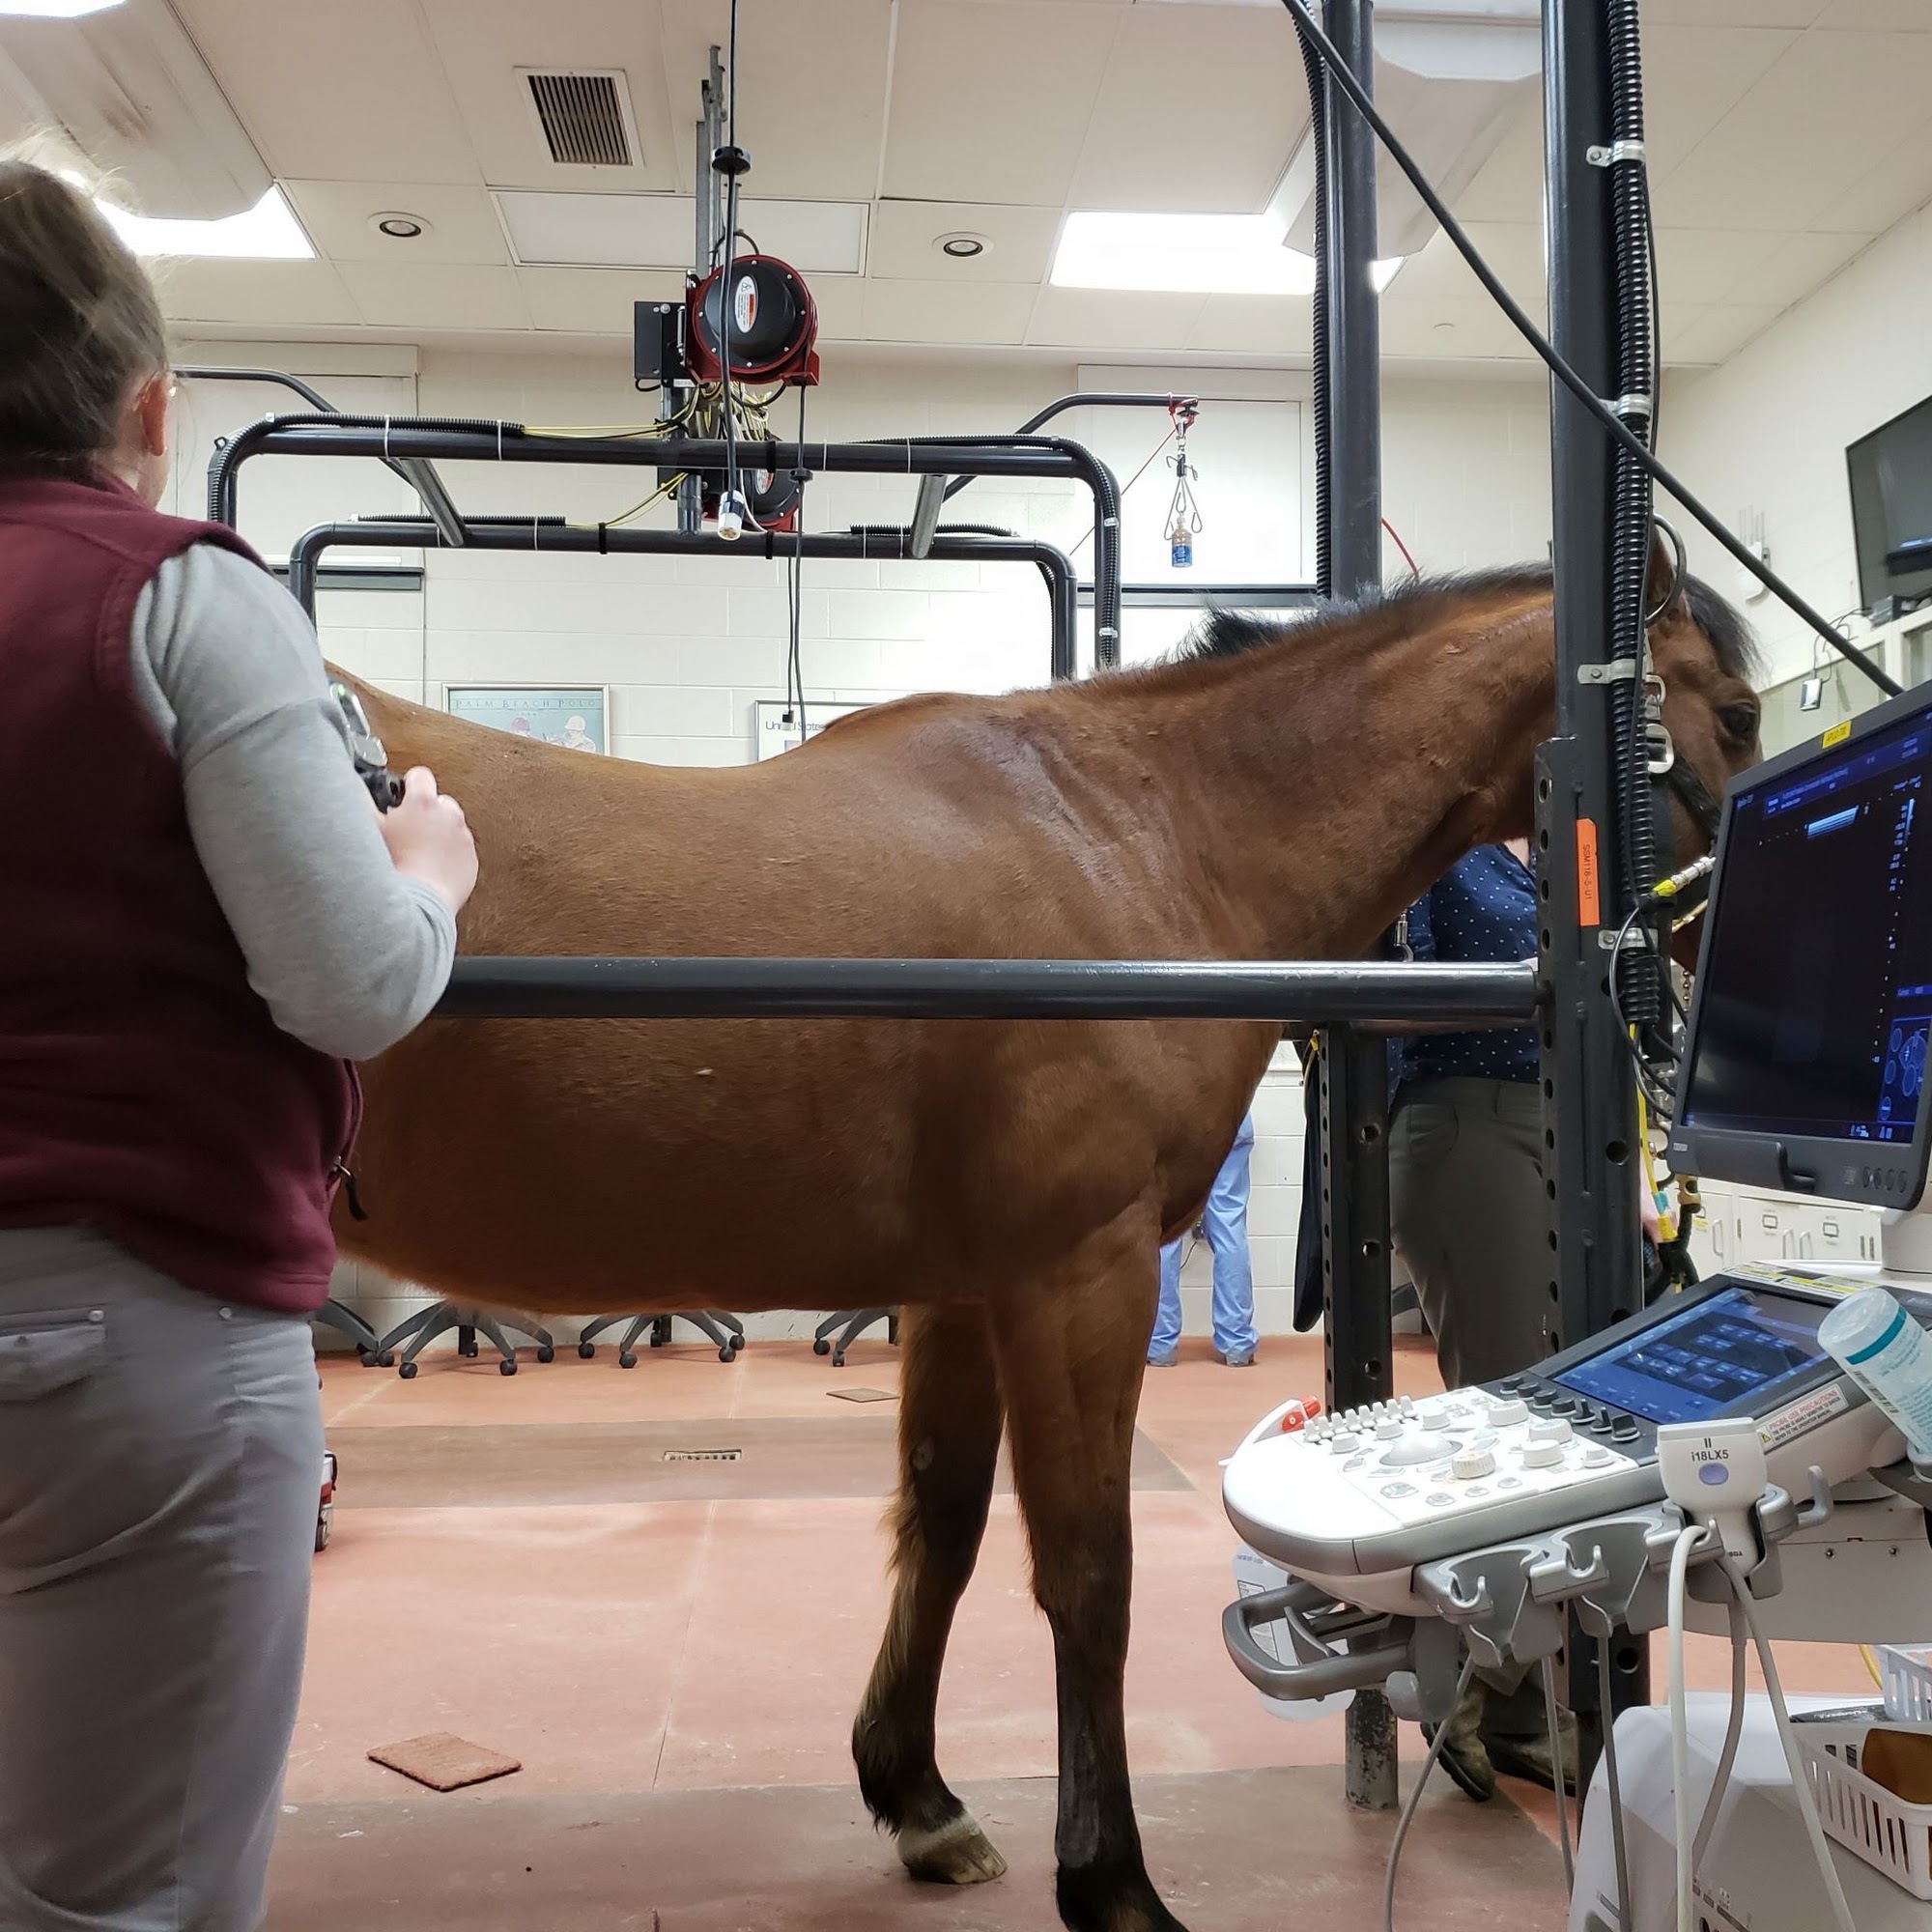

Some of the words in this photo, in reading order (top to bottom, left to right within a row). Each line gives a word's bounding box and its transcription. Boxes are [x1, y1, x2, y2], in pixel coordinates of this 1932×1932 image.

[456, 699, 494, 708] PALM
[502, 699, 550, 708] BEACH
[558, 699, 595, 708] POLO
[765, 721, 796, 730] Unid
[798, 721, 824, 731] Sates
[1690, 1449, 1729, 1462] i18LX5
